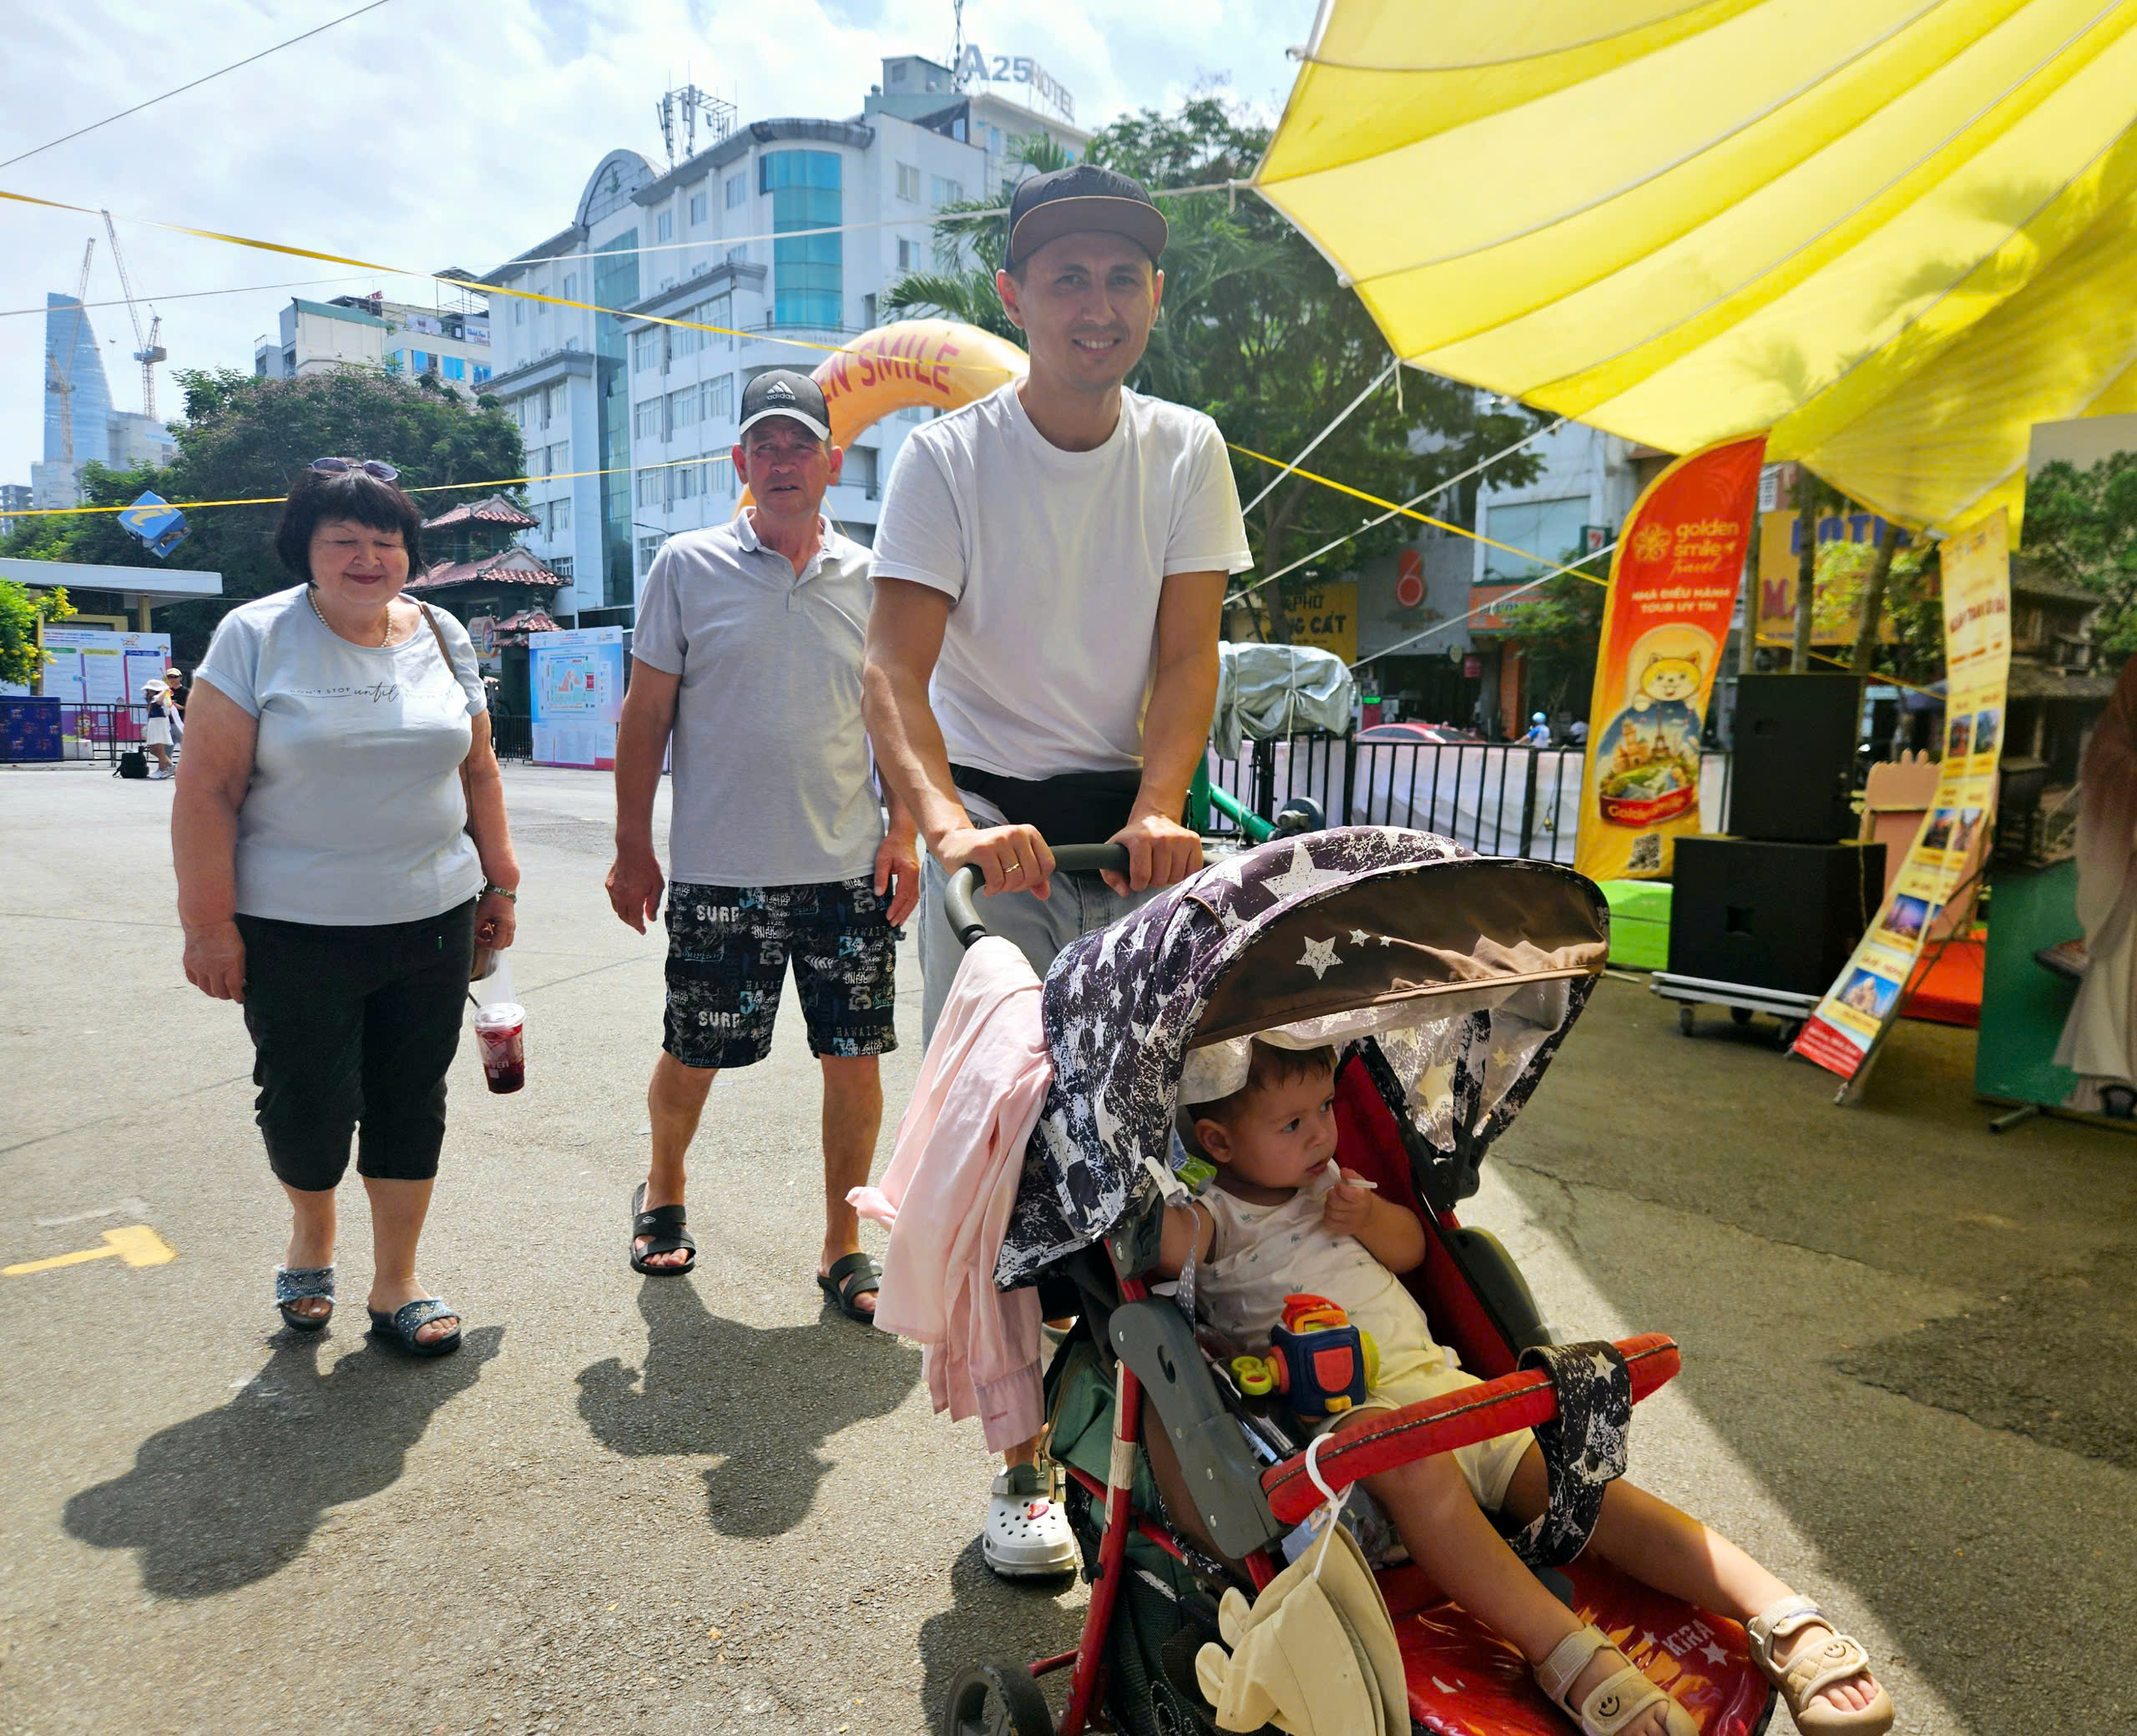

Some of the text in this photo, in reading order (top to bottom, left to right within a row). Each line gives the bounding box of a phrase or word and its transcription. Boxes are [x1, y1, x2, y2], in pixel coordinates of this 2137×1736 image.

[956, 43, 1032, 83] A25
[857, 333, 960, 396] SMILE
[1309, 610, 1347, 634] CÁT
[354, 682, 401, 703] until
[696, 905, 740, 922] SURF
[698, 1011, 741, 1028] SURF
[1663, 1617, 1716, 1657] KIRA
